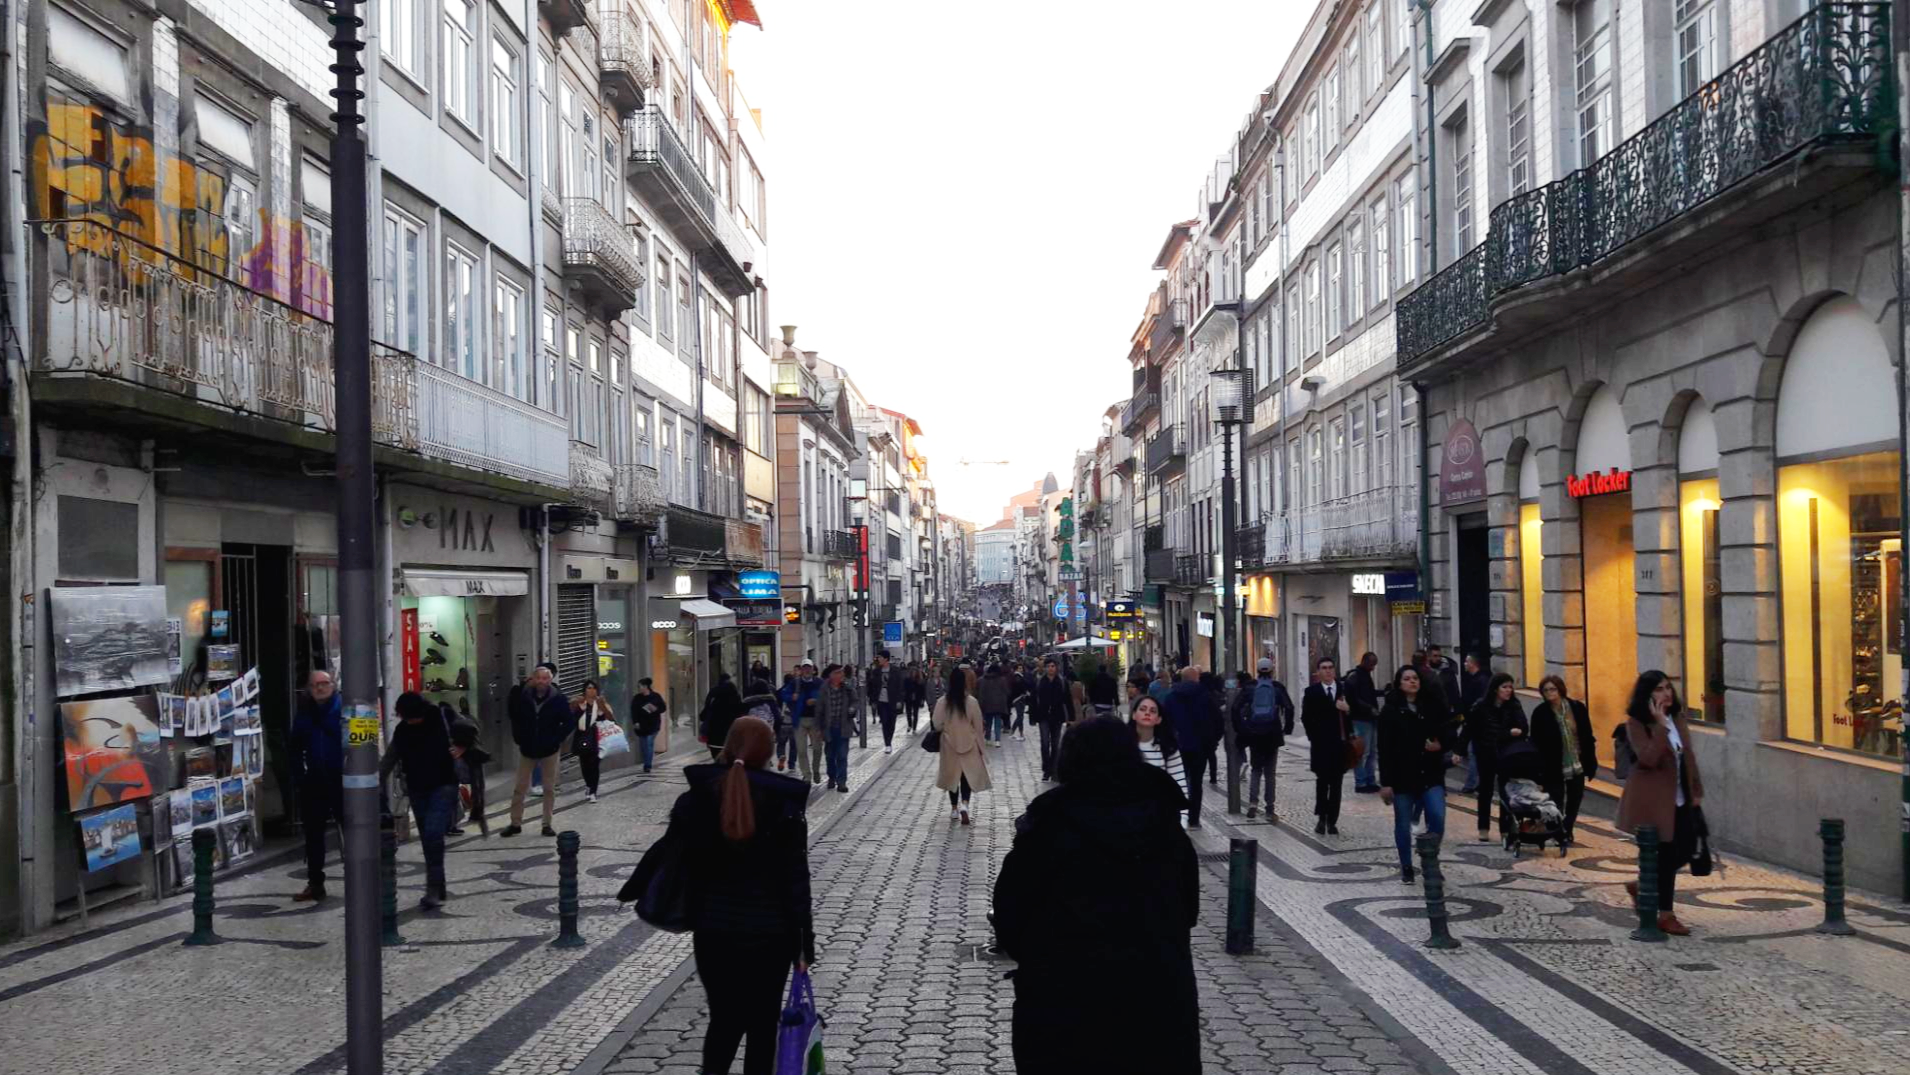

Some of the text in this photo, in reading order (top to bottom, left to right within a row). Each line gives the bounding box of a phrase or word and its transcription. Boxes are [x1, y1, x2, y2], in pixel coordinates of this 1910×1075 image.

[1567, 467, 1633, 497] Foot Locker
[439, 506, 494, 552] MAX
[466, 581, 485, 593] MAX
[652, 621, 677, 629] ecco
[1833, 713, 1848, 726] Foot
